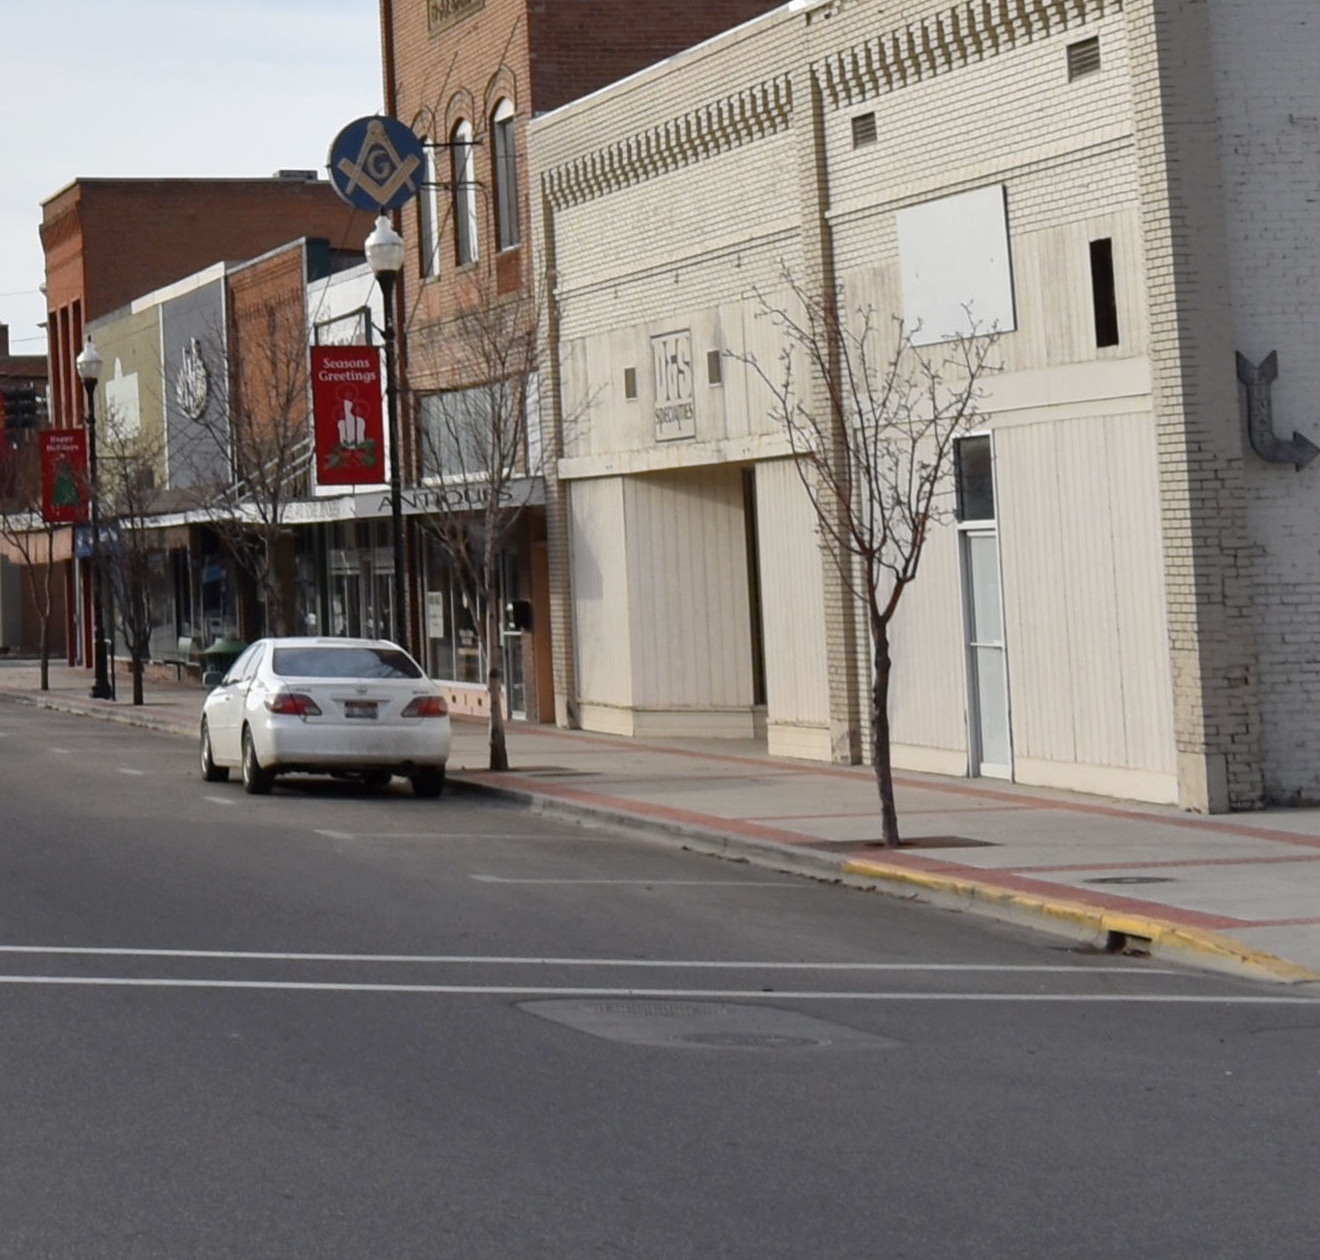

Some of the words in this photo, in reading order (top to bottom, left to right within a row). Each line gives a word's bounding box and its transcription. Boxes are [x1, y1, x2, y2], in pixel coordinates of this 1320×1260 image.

[367, 150, 390, 179] G
[323, 357, 370, 369] Seasons
[318, 370, 376, 383] Greetings
